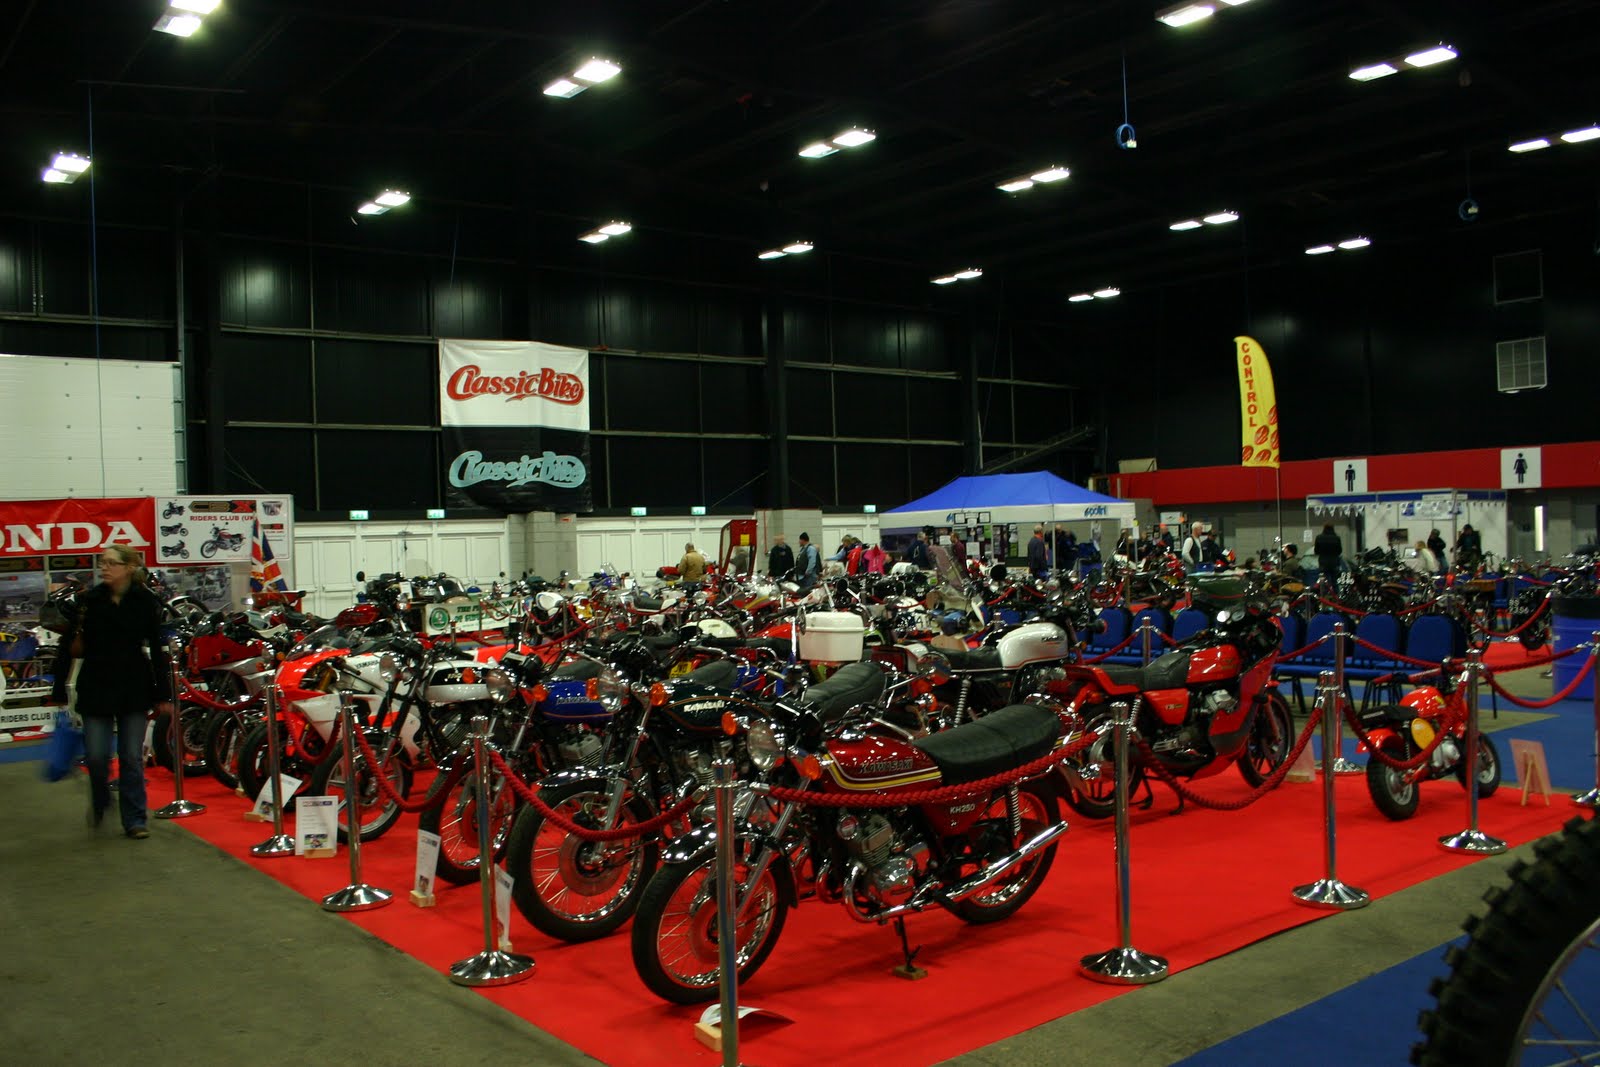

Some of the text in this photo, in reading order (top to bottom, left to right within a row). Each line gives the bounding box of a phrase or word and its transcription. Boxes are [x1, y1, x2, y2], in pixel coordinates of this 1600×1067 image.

[1241, 342, 1258, 428] CONTROL
[0, 521, 150, 553] NDA
[31, 712, 51, 721] CLUB
[950, 803, 976, 814] KH250
